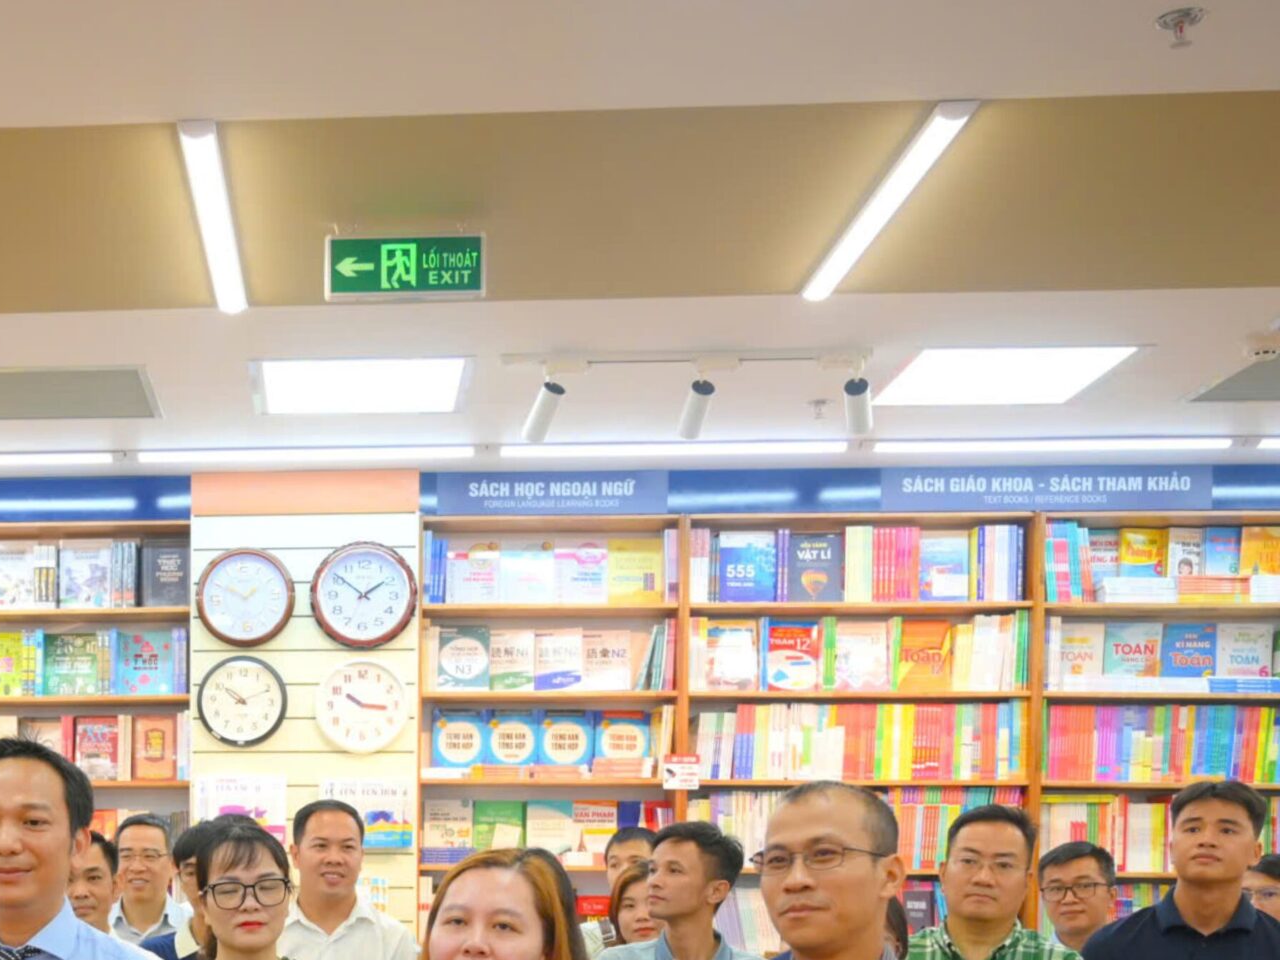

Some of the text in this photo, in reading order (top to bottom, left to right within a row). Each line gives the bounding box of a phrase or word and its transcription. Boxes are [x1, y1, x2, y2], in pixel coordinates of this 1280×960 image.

[442, 248, 479, 268] THOÁT
[428, 270, 472, 285] EXIT
[469, 479, 636, 499] SÁCH HỌC NGOẠI NGỮ
[902, 474, 945, 494] SÁCH
[949, 474, 988, 493] GIÁO
[992, 477, 1034, 493] KHOA
[1049, 474, 1093, 492] SÁCH
[1097, 477, 1143, 491] THAM
[1147, 472, 1191, 491] KHẢO
[726, 564, 755, 578] 555
[455, 664, 473, 675] N3
[1259, 665, 1269, 677] 6
